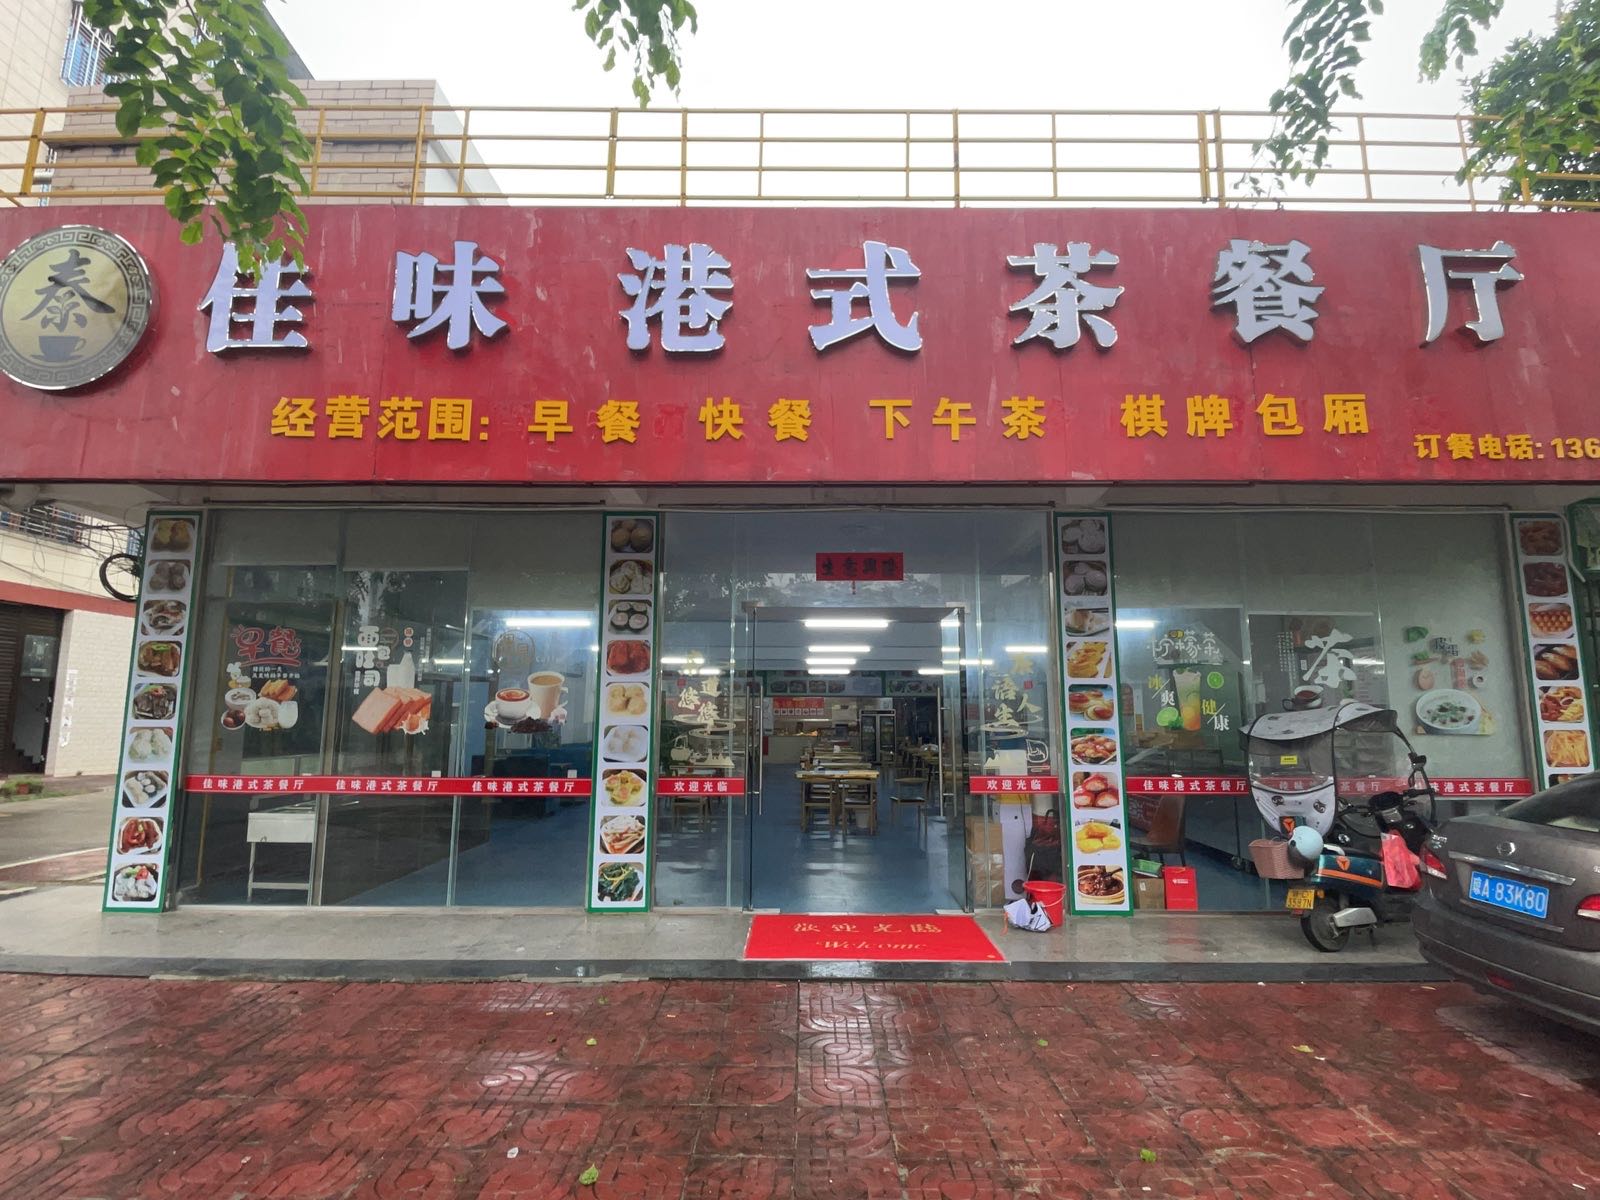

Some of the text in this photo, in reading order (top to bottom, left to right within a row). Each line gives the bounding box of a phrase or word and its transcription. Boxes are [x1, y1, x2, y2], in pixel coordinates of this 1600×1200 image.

[199, 240, 1524, 353] 佳味港式茶餐厅
[528, 399, 640, 443] 早餐
[699, 397, 812, 442] 快餐
[869, 395, 1046, 441] 下午茶
[1120, 393, 1369, 438] 棋牌包厢
[1152, 629, 1220, 660] 柠檬茶
[1303, 628, 1357, 689] 茶
[202, 778, 305, 792] 佳味港式茶餐厅
[335, 779, 439, 792] 佳味港式茶餐厅
[472, 780, 575, 793] 佳味港式茶餐厅
[673, 780, 729, 793] 欢迎光临
[986, 779, 1042, 792] 欢迎光临
[1143, 779, 1247, 792] 佳味港式茶餐厅
[817, 939, 928, 950] Welcome
